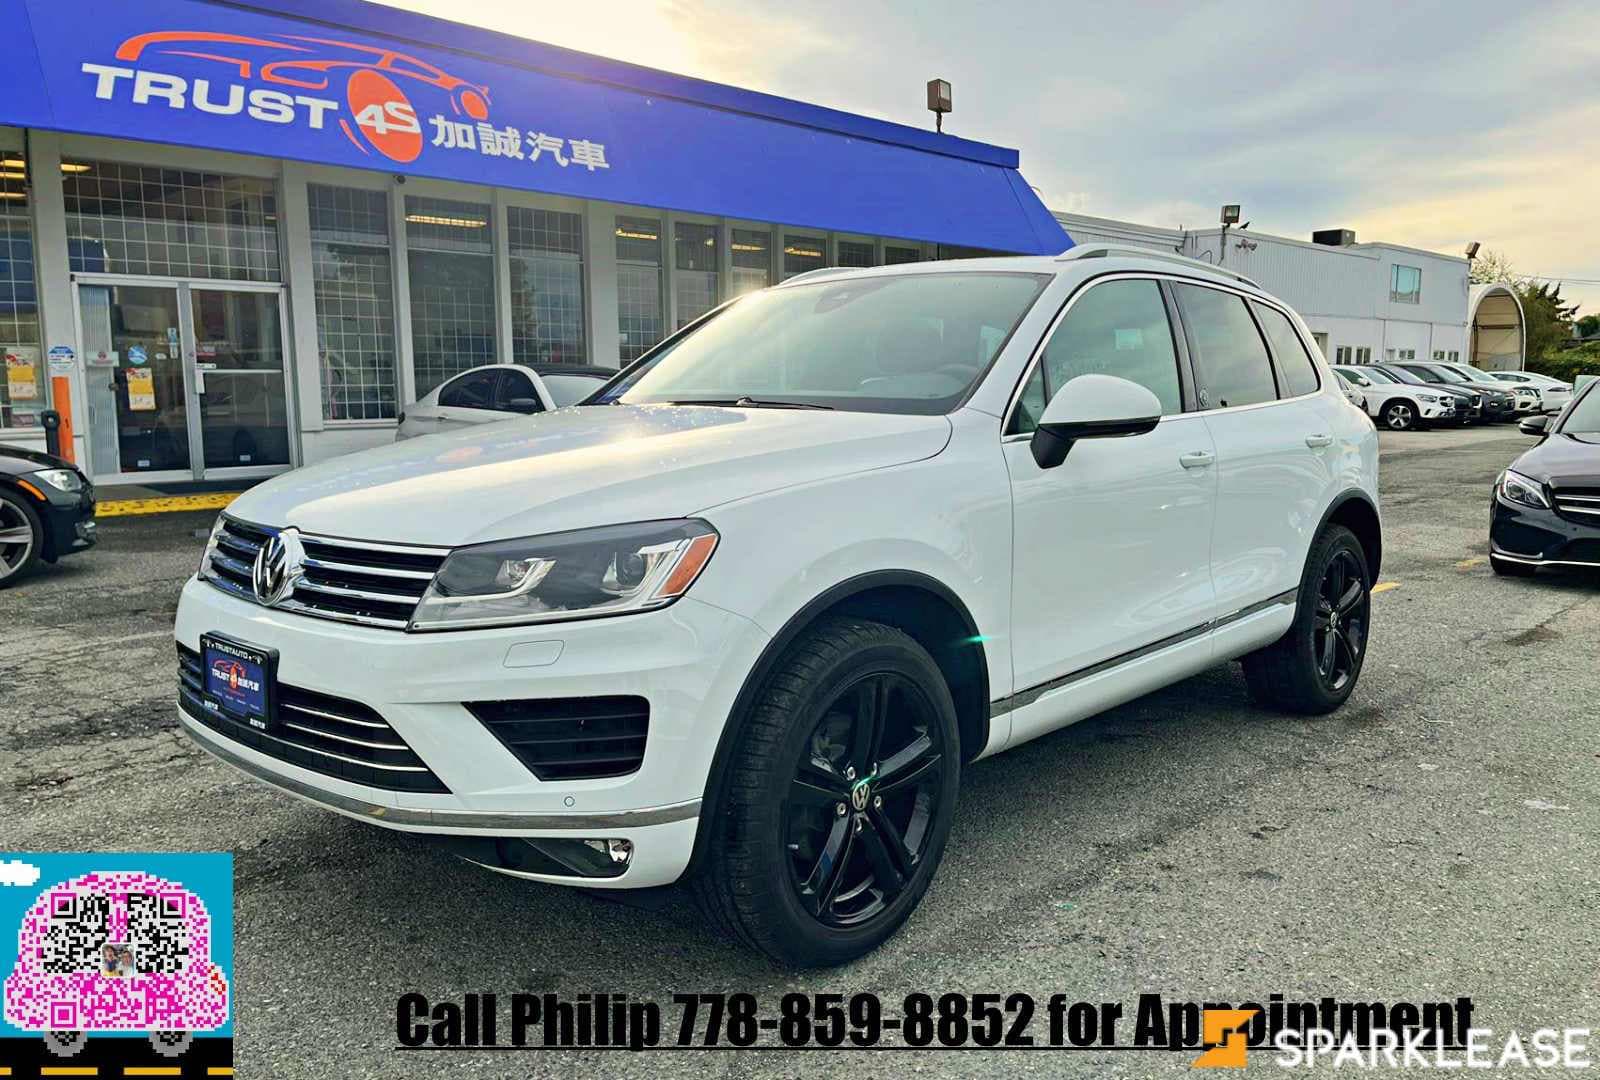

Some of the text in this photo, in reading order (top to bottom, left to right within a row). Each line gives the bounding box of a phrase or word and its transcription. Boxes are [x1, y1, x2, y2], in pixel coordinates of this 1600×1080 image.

[82, 63, 421, 134] TRUST 4S
[429, 115, 610, 171] 加誠汽車
